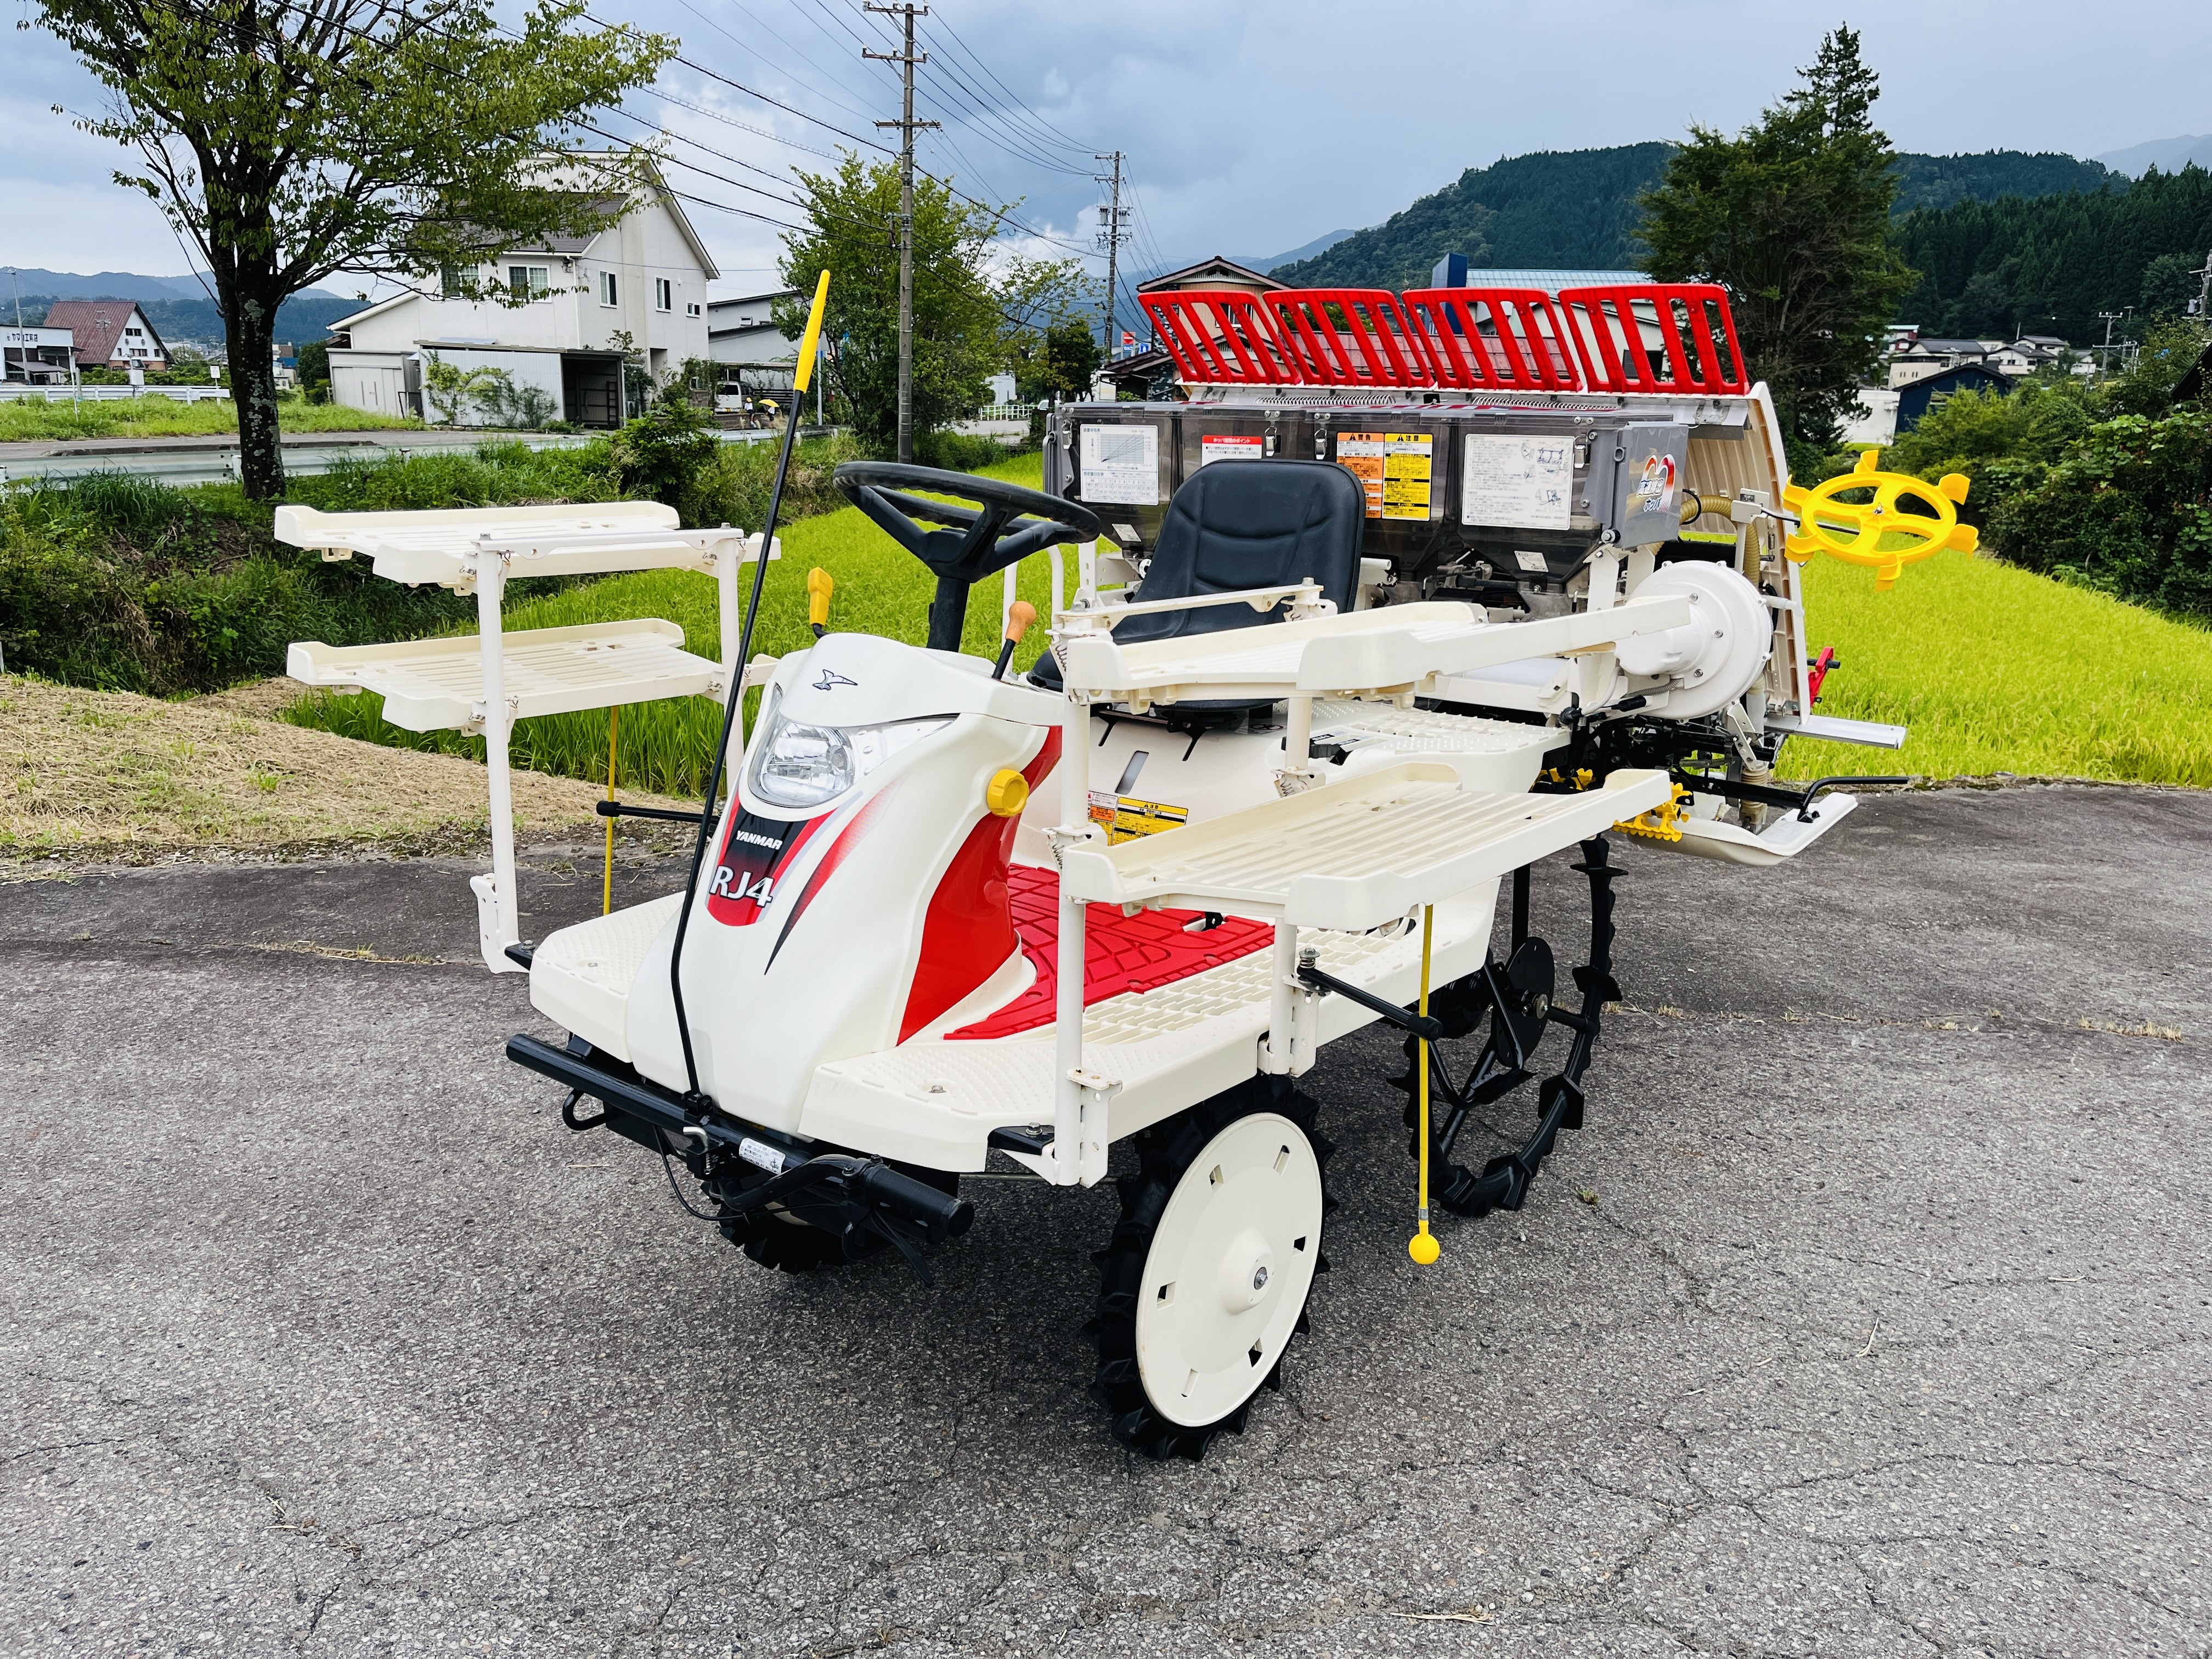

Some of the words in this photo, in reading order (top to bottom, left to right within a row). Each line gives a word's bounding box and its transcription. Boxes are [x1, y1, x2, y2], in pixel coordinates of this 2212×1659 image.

[1644, 498, 1662, 512] ホッパ
[736, 830, 783, 850] YANMAR
[709, 865, 775, 907] RJ4
